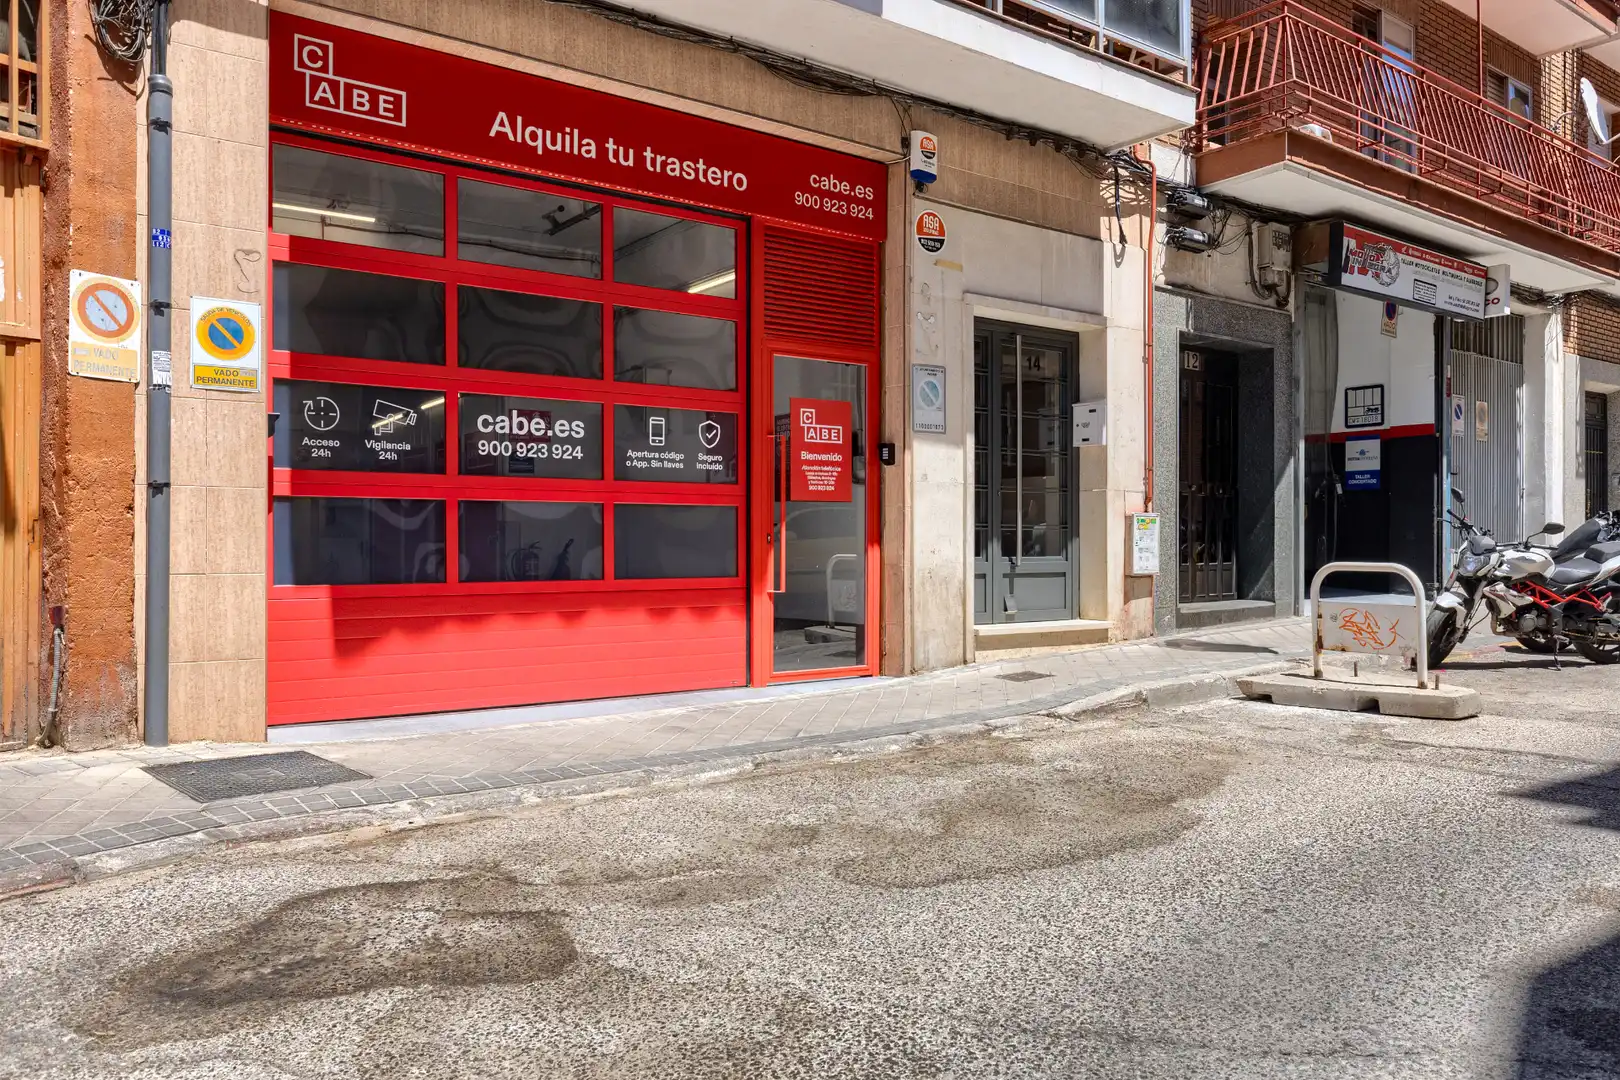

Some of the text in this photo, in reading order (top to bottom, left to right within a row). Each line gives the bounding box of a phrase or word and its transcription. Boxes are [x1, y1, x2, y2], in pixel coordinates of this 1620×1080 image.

[489, 111, 748, 192] Alquila tu trastero
[810, 173, 874, 200] cabe.es
[795, 191, 874, 220] 900 923 924
[923, 214, 940, 231] ASA
[94, 348, 119, 360] VADO
[1186, 351, 1199, 369] 12
[74, 360, 137, 377] PERMANENTE
[1026, 355, 1041, 372] 14
[213, 369, 239, 377] VADO
[196, 376, 255, 387] PERMANENTE
[477, 409, 585, 438] cabe.es
[302, 436, 341, 447] Acceso
[364, 439, 411, 451] Vigilancia
[311, 448, 331, 458] 24h
[379, 451, 398, 460] 24h
[478, 440, 584, 460] 900 923 924
[627, 449, 685, 461] Apertura código
[801, 450, 843, 462] Bienvenido
[698, 452, 723, 463] Seguro
[632, 459, 650, 468] App.
[664, 460, 684, 469] llaves
